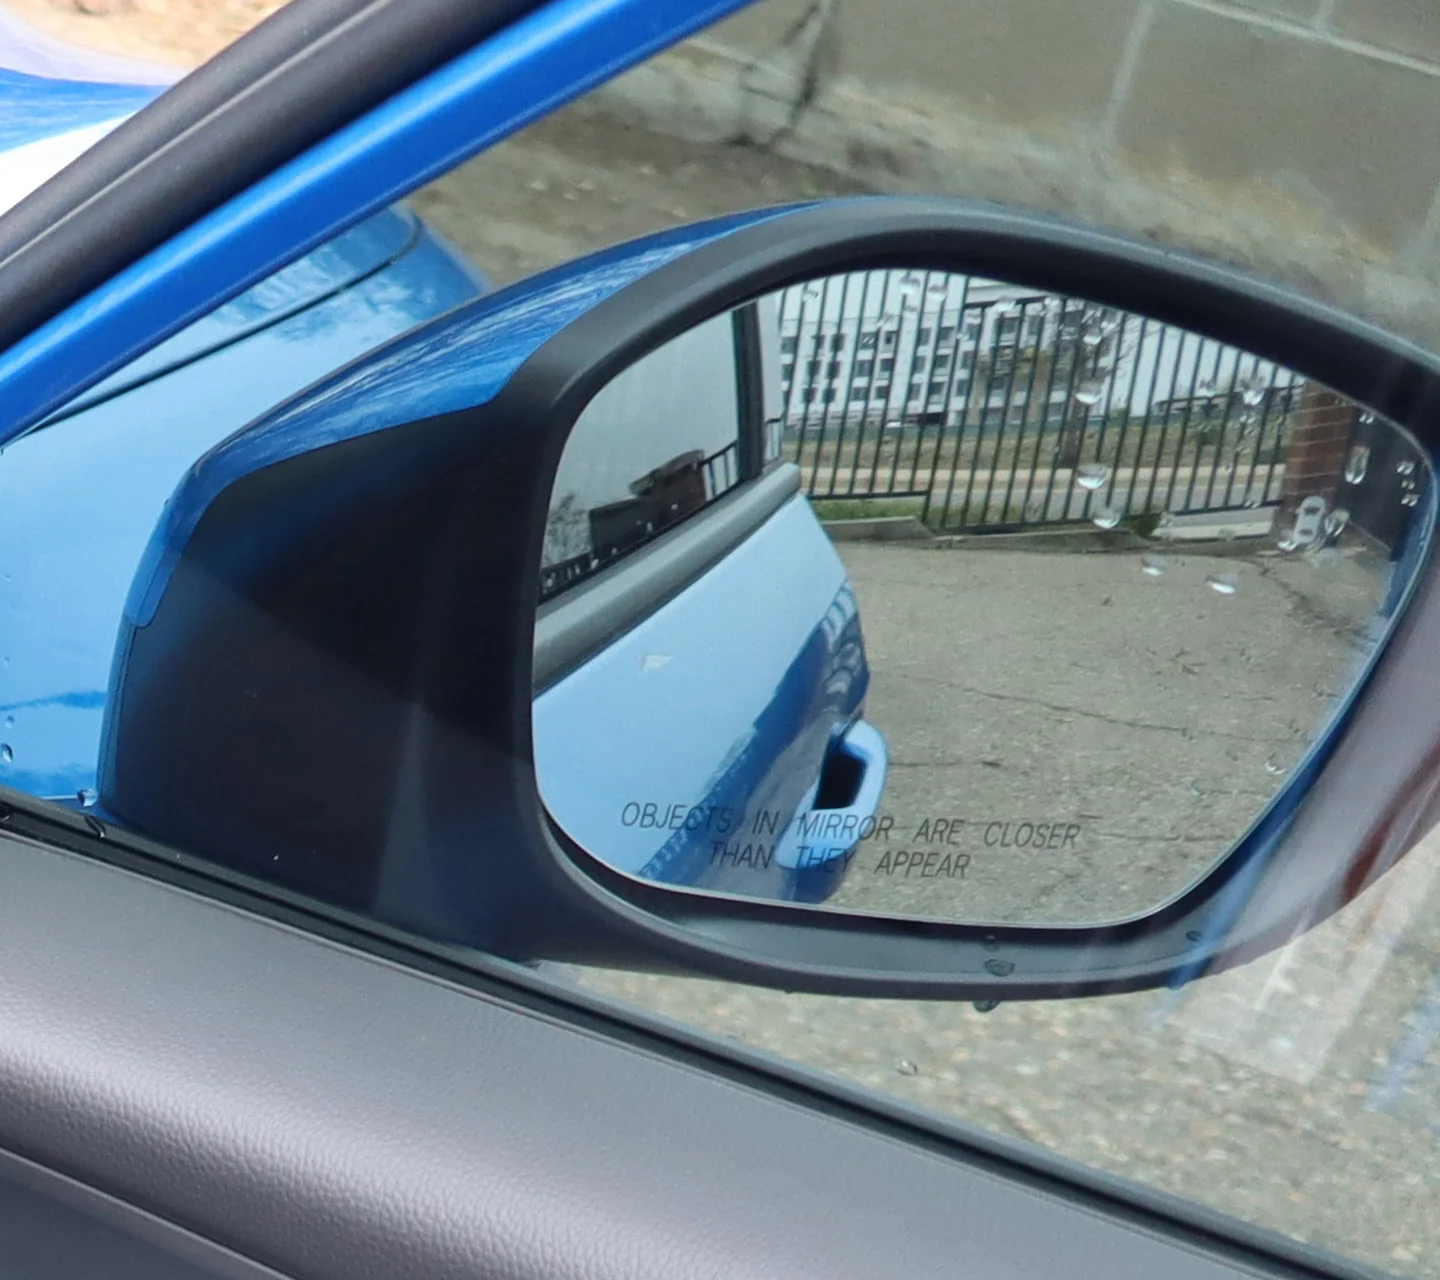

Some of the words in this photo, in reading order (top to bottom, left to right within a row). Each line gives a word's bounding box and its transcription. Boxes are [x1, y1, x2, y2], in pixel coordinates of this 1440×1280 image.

[620, 802, 732, 835] OBJECTS
[752, 810, 779, 837] IN
[795, 812, 894, 842] MIRROR
[911, 818, 964, 847] ARE
[983, 821, 1080, 850] CLOSER
[709, 840, 774, 869] THAN
[795, 844, 853, 873] THEY
[874, 848, 971, 879] APPEAR
